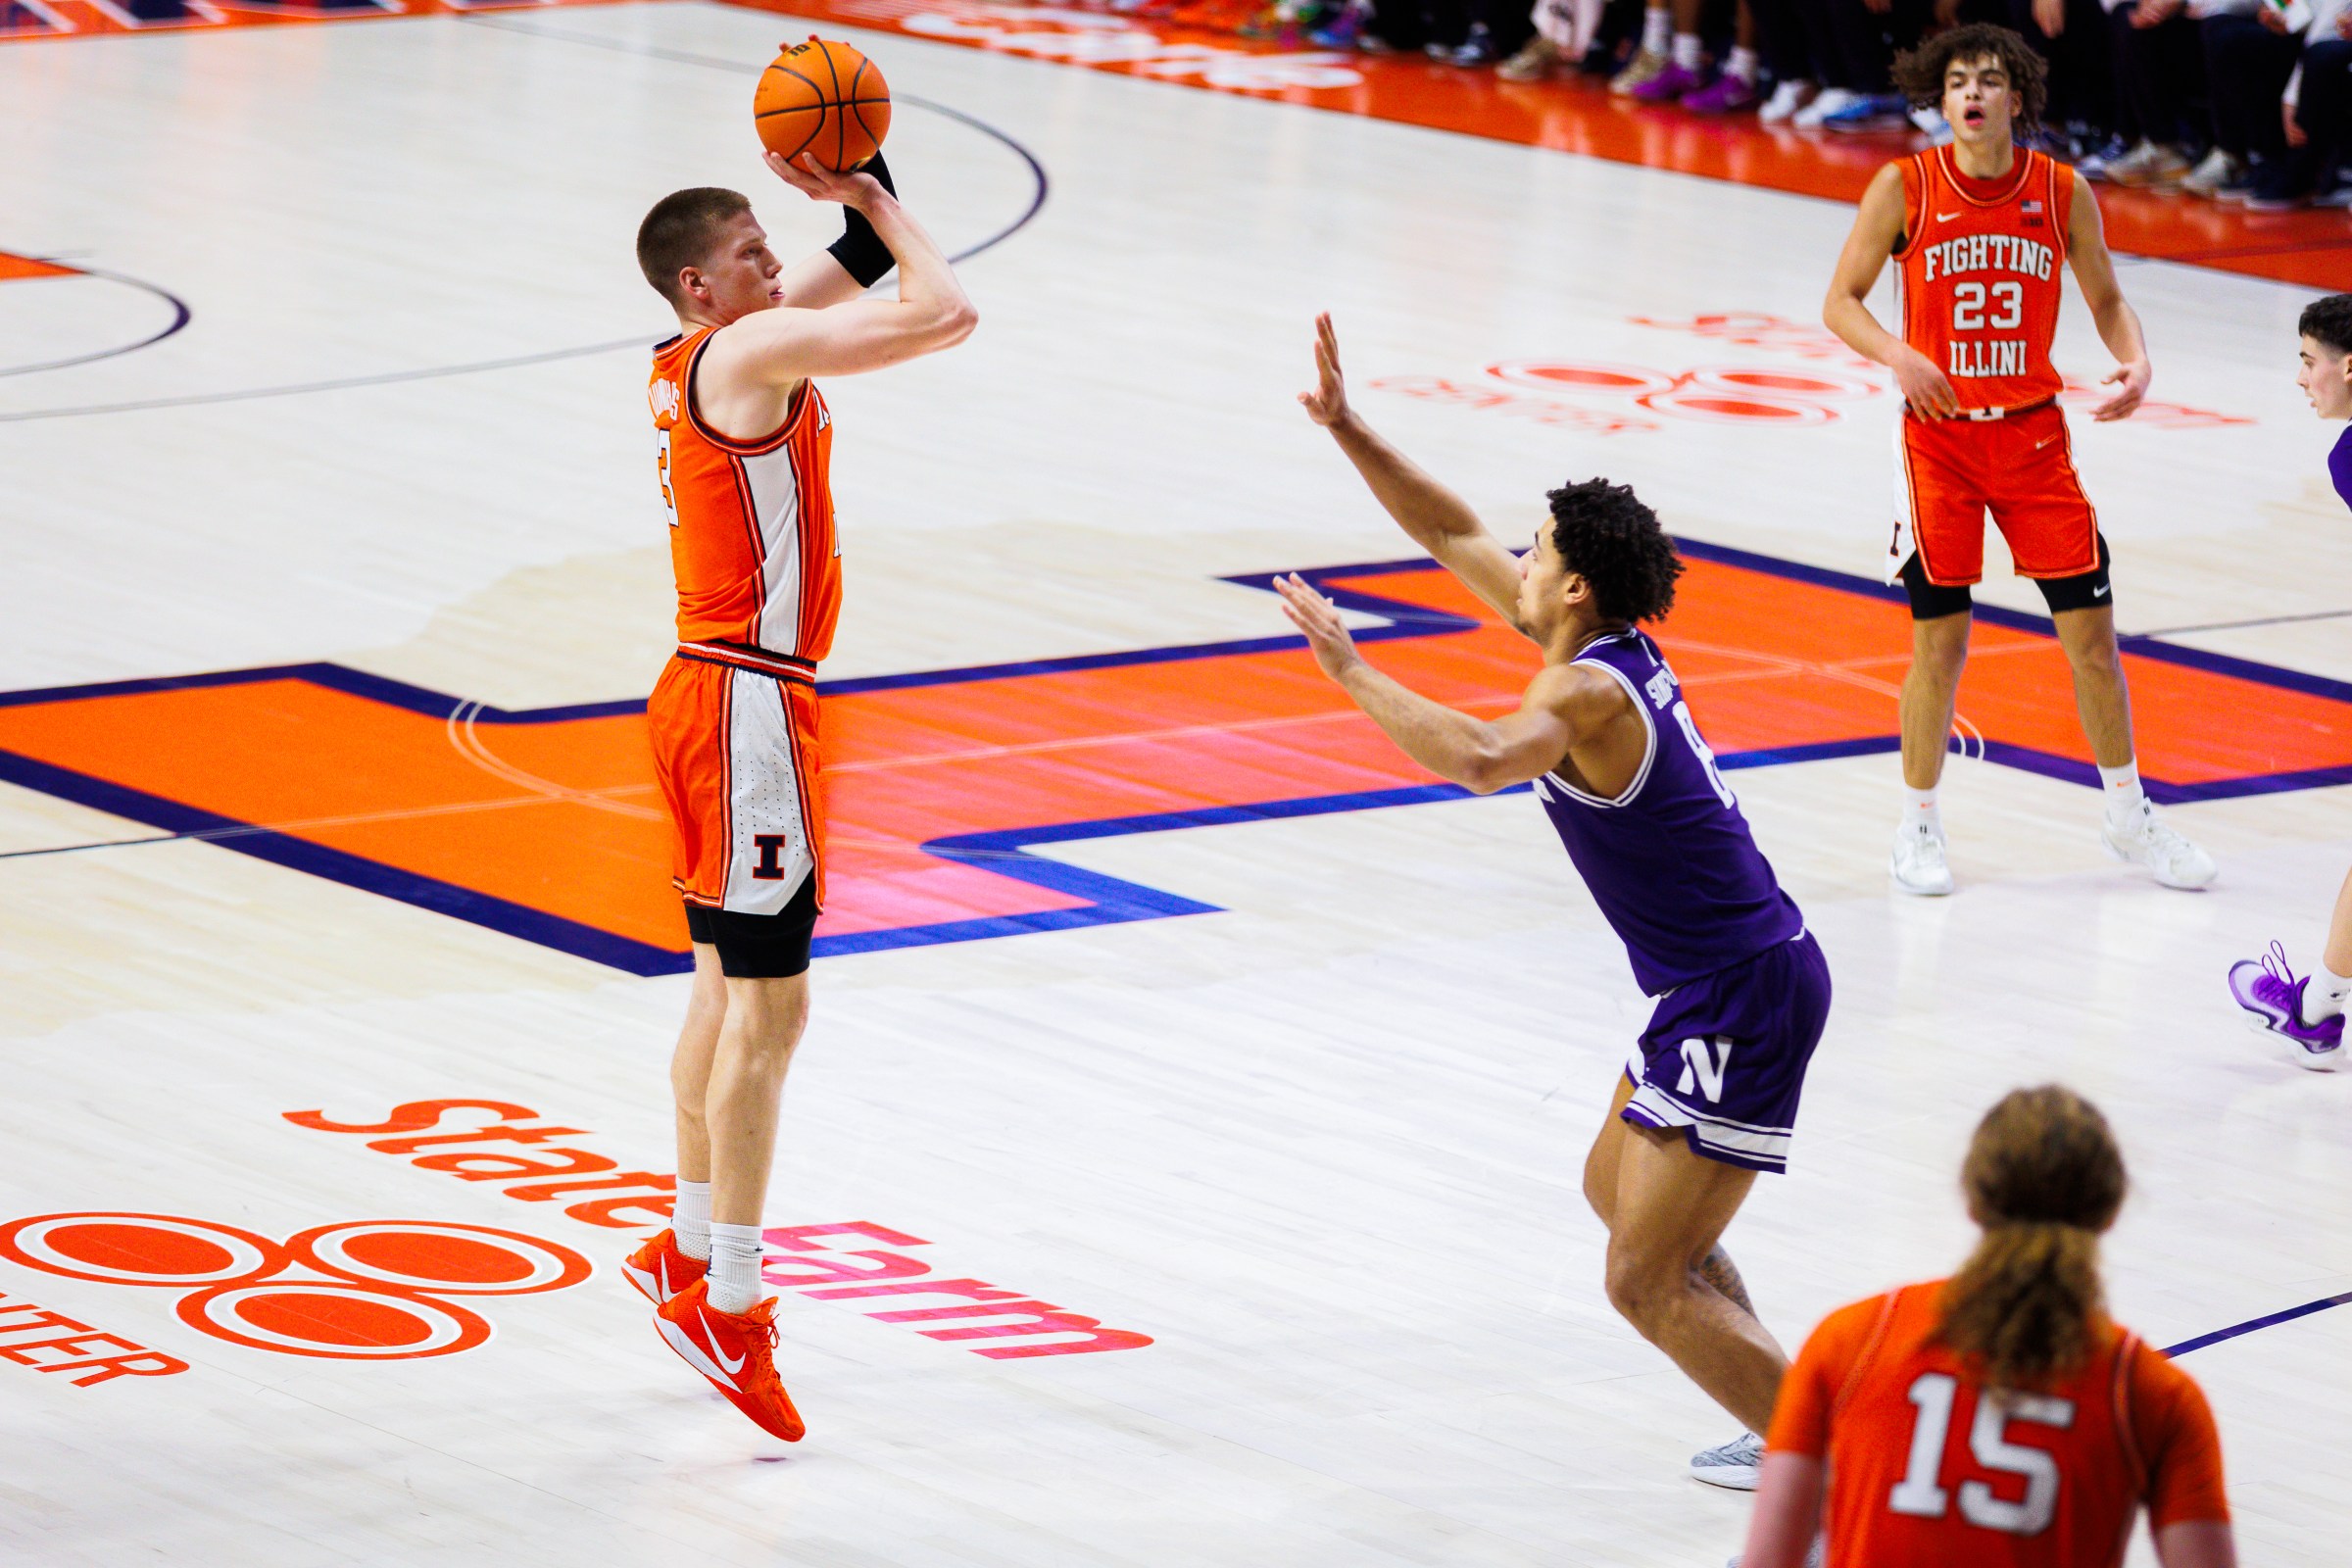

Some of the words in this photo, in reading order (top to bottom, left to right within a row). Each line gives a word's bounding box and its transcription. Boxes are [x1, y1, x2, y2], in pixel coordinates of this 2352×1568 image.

[1924, 234, 2054, 282] FIGHTING
[1953, 280, 2024, 331] 23
[1949, 339, 2028, 378] ILLINI
[753, 834, 786, 880] I
[1675, 1034, 1734, 1103] N
[1887, 1370, 2077, 1537] 15
